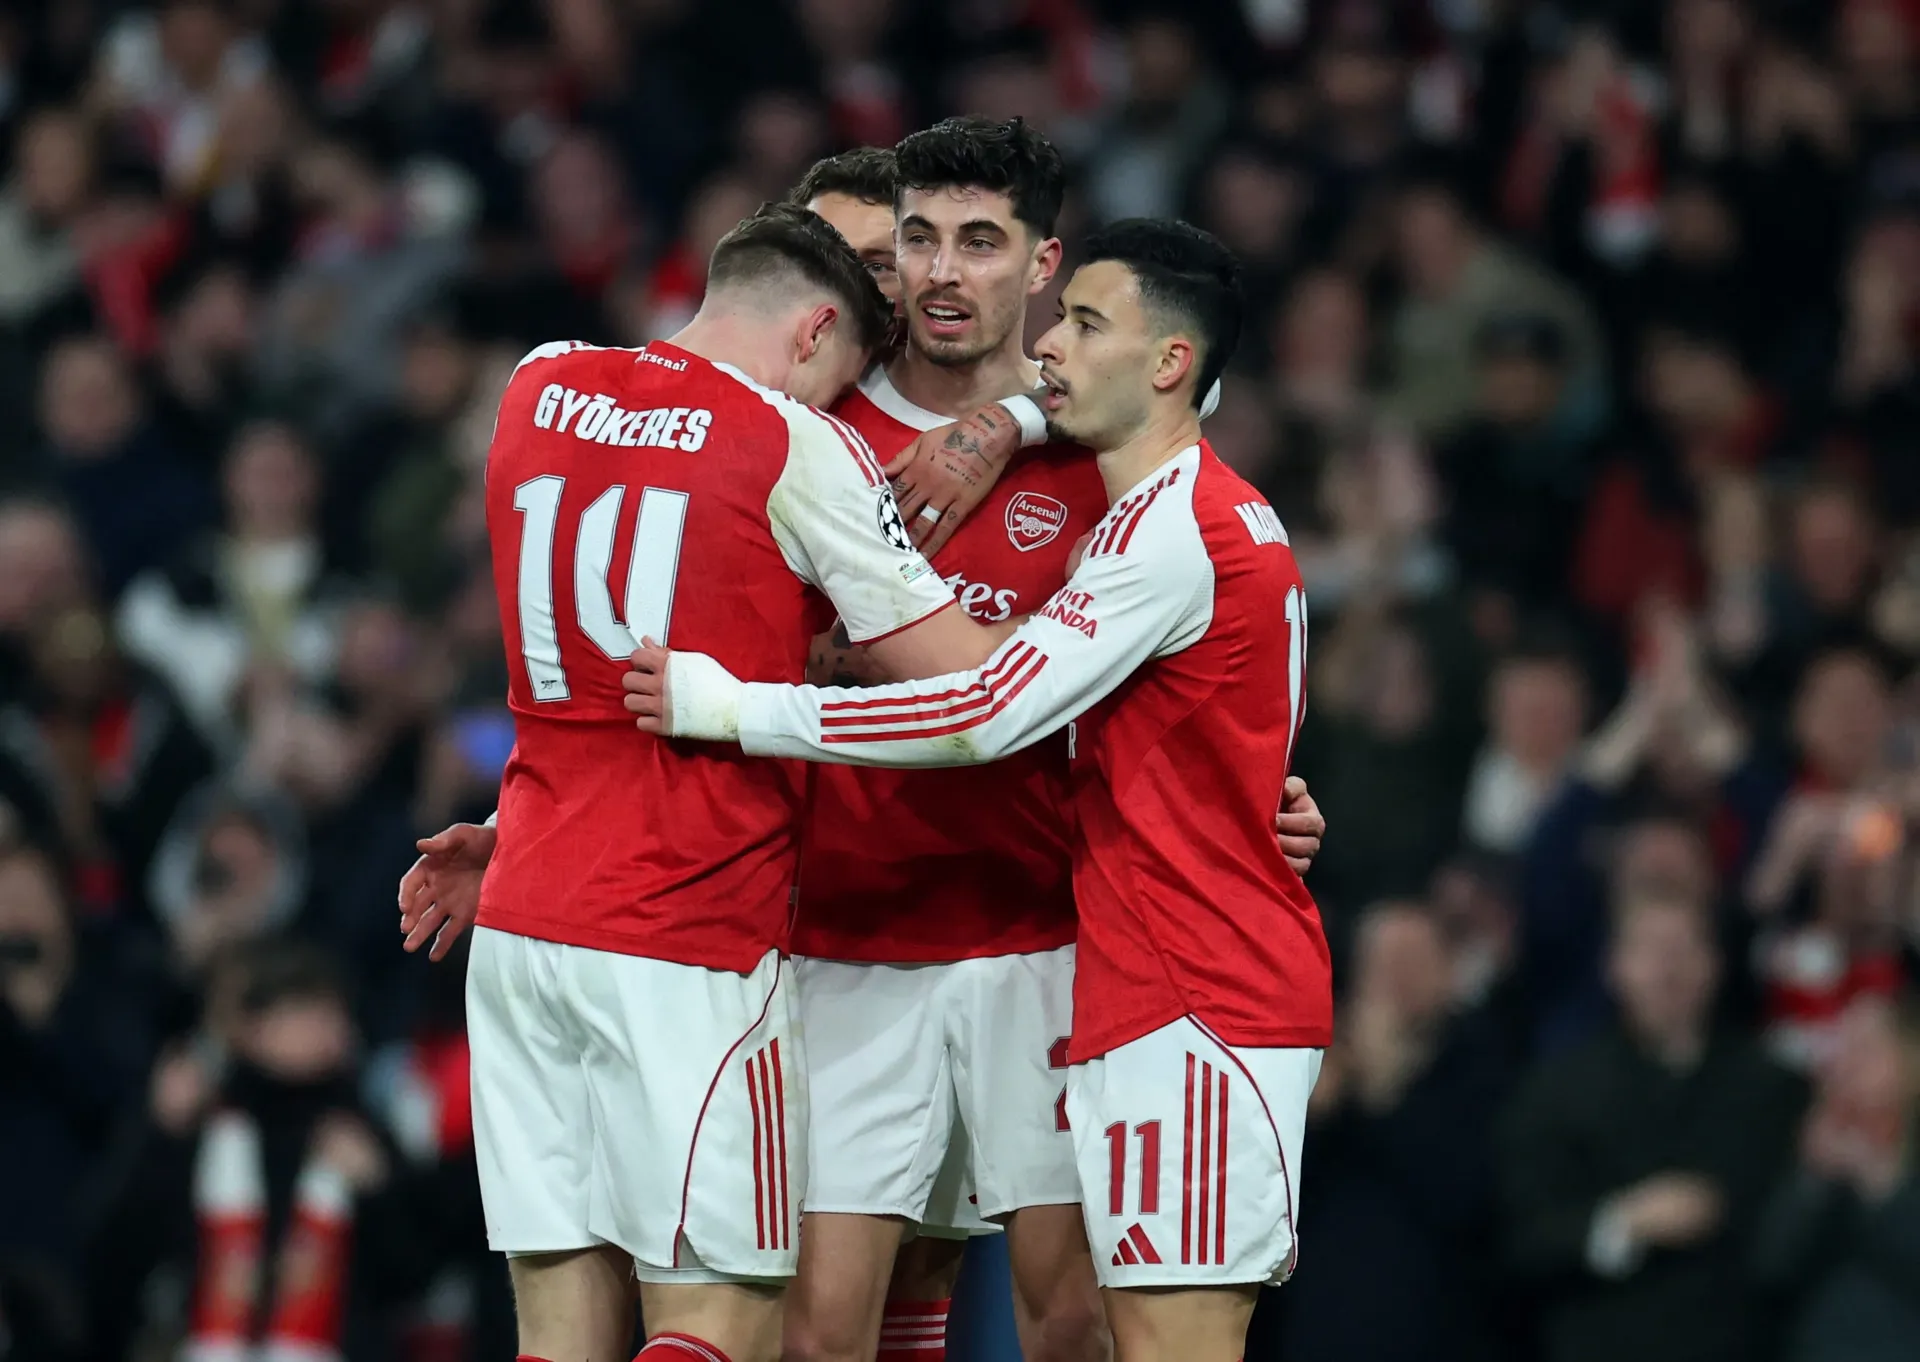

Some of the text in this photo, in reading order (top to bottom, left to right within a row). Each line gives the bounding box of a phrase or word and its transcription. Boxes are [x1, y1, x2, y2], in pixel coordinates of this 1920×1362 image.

[533, 383, 713, 453] GYÖKERES
[1017, 499, 1060, 521] Arsenal
[513, 474, 691, 703] 14
[1103, 1119, 1162, 1217] 11
